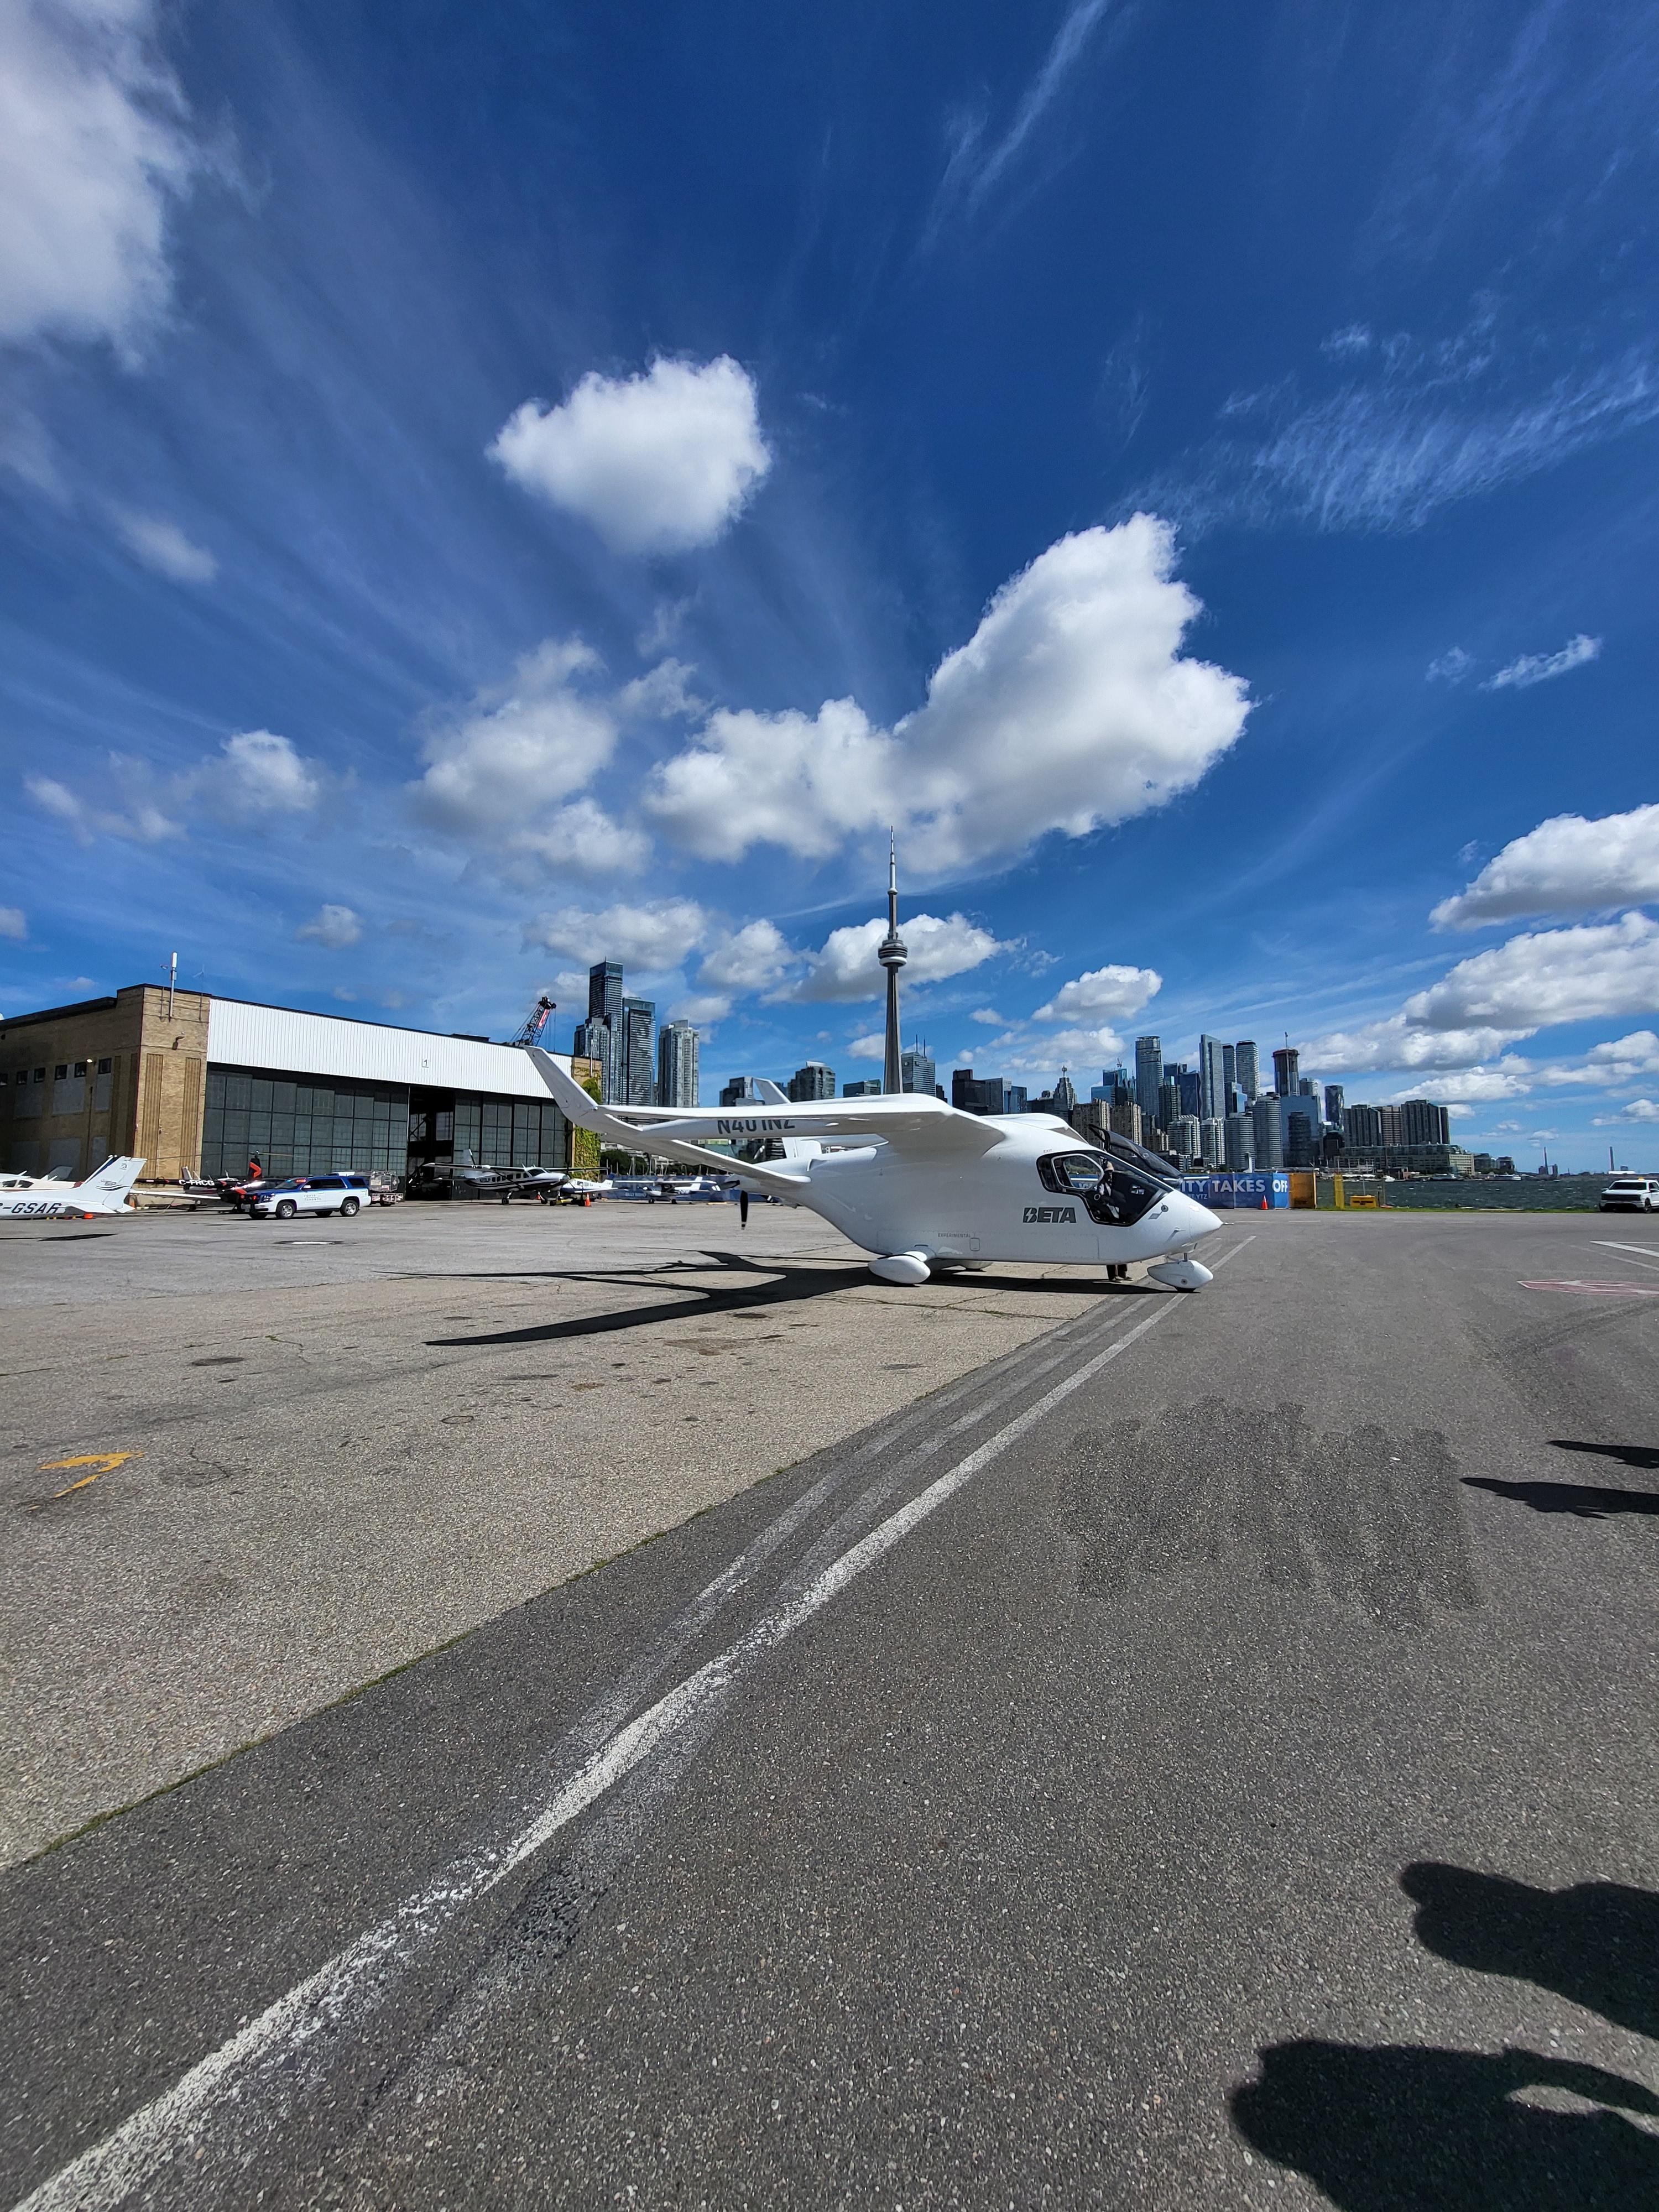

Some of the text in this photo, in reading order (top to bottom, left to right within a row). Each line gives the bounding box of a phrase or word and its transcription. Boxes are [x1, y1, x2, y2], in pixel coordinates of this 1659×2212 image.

[1178, 1180, 1288, 1193] ITY TAKES OFF
[1022, 1207, 1076, 1223] BETA
